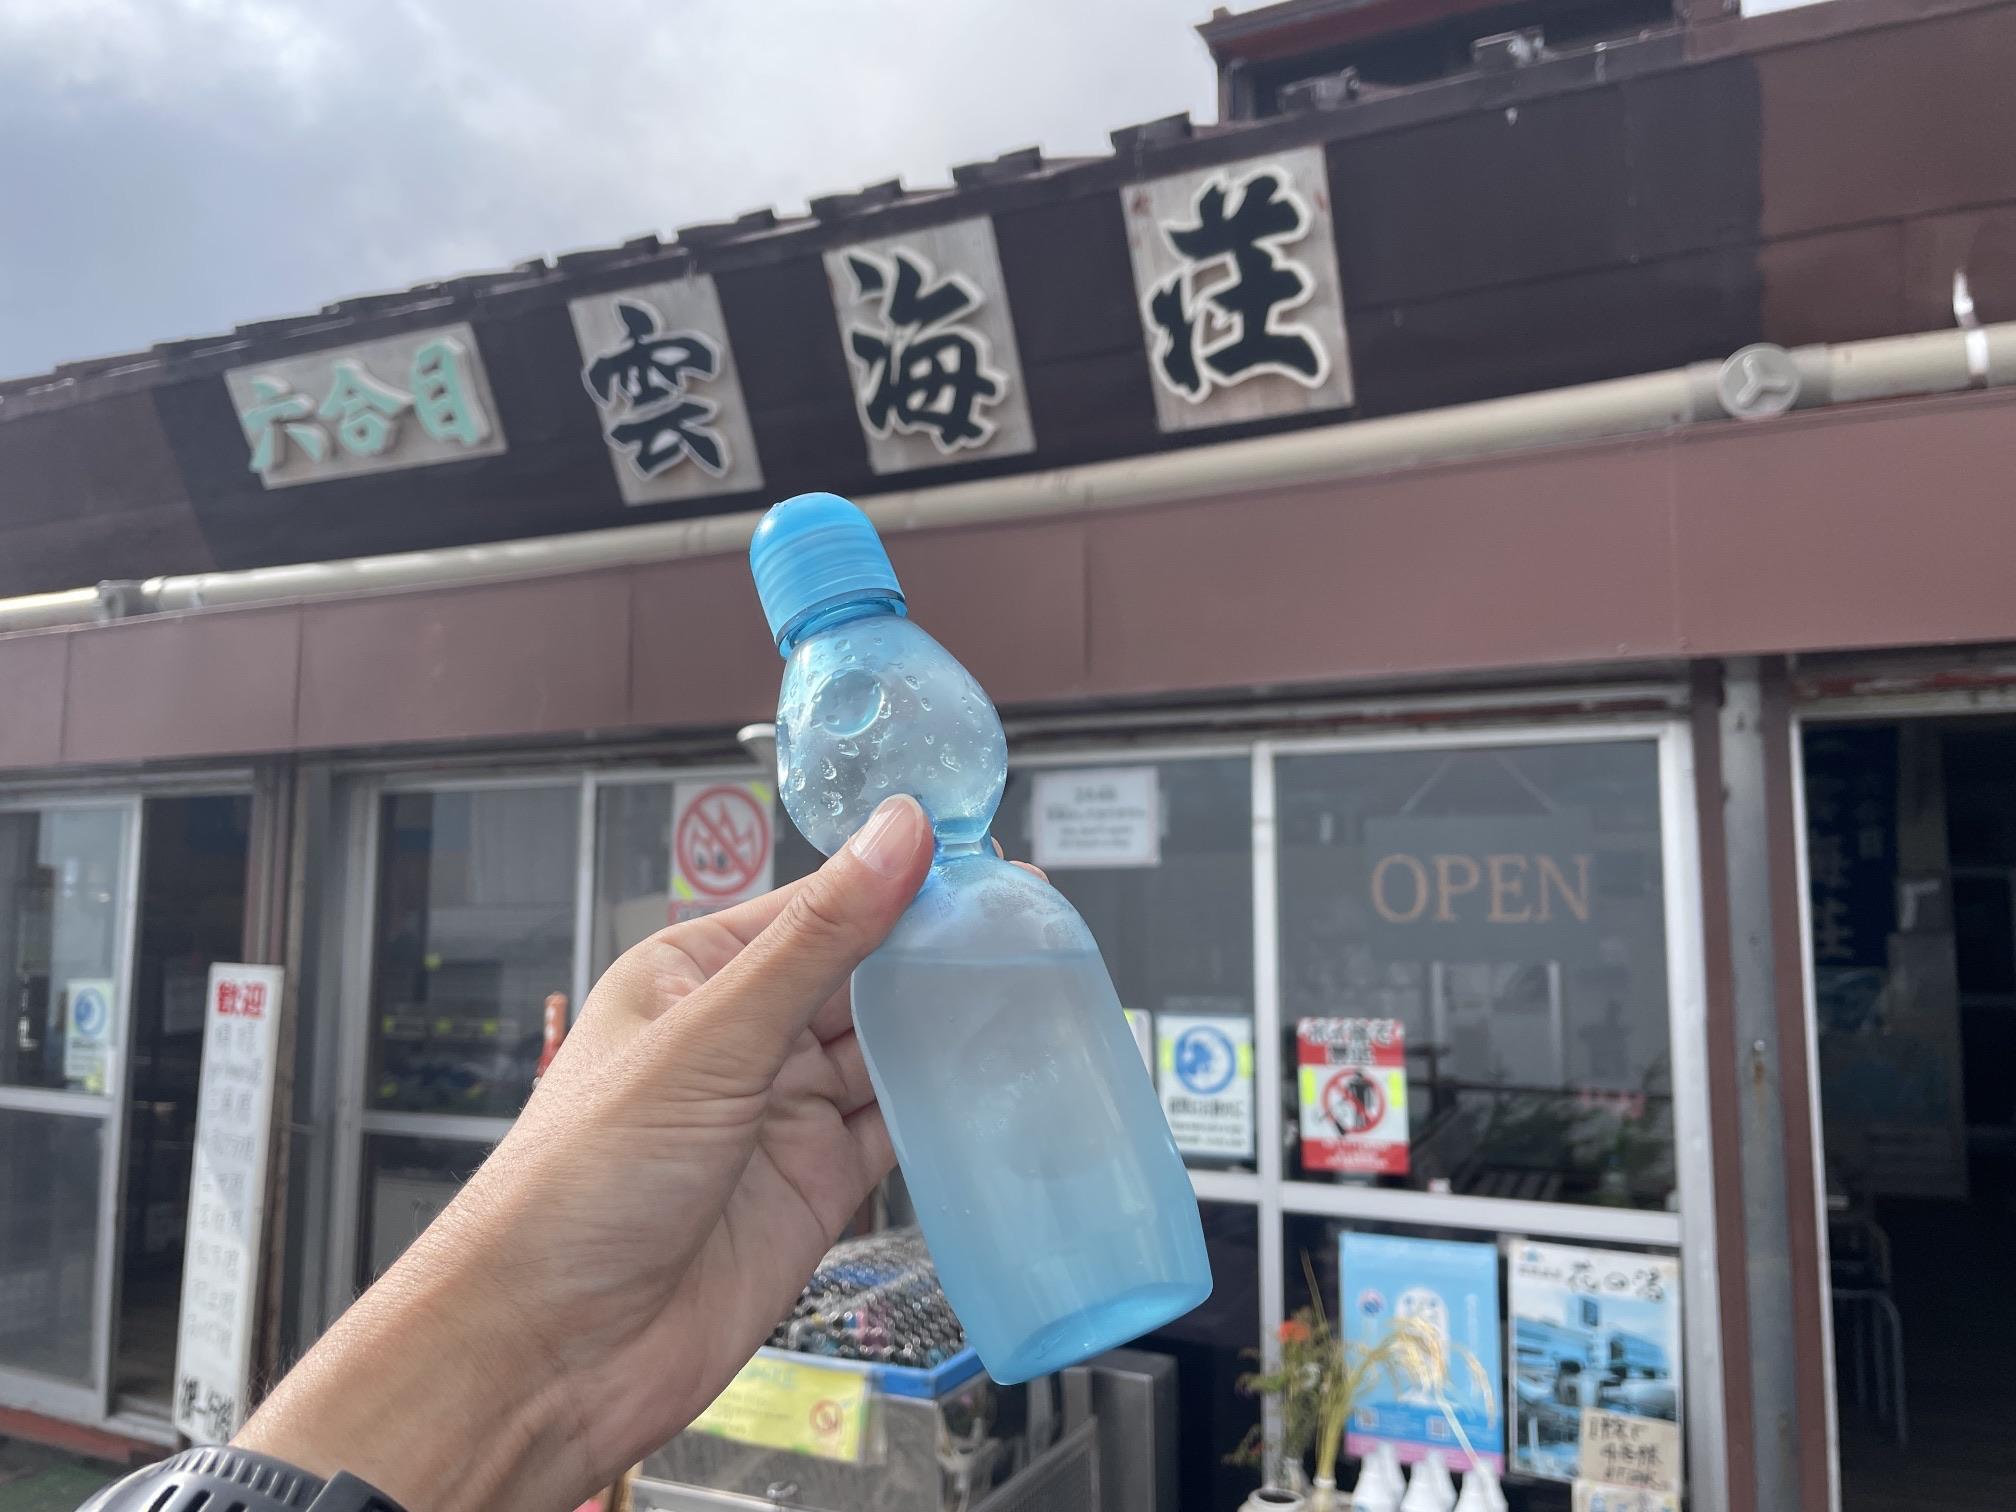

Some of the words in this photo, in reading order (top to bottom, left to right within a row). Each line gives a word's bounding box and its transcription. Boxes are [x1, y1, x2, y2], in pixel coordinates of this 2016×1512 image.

[242, 336, 489, 472] 六合目
[582, 165, 1328, 479] 雲海荘
[1370, 853, 1592, 924] OPEN
[215, 981, 267, 1019] 歓迎
